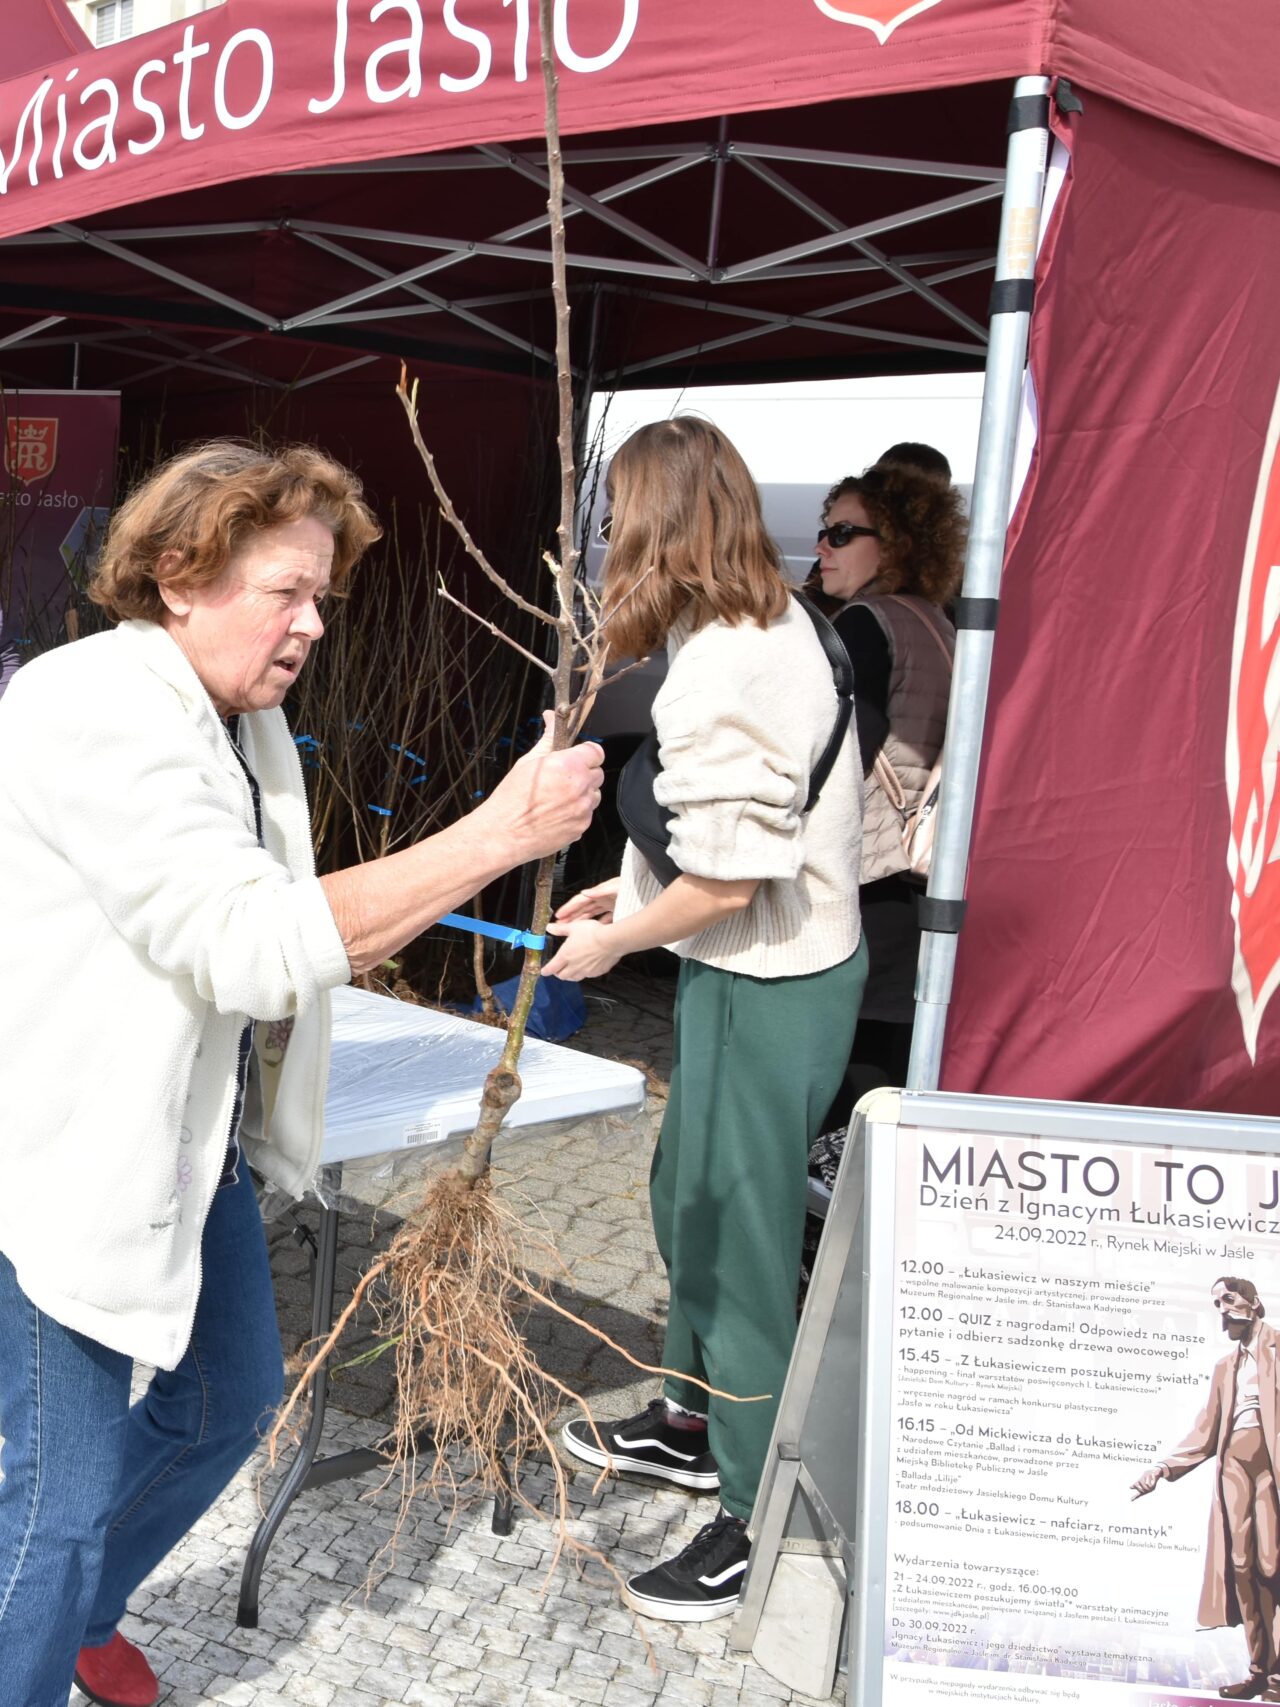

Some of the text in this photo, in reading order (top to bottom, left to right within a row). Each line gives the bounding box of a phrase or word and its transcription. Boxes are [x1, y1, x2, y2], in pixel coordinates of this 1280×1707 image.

[922, 1143, 1119, 1196] MIASTO
[1154, 1160, 1224, 1205] TO
[919, 1183, 988, 1211] Dzień
[998, 1199, 1009, 1213] z
[1019, 1192, 1120, 1223] Ignacym
[994, 1223, 1086, 1246] 24.09.2022
[1106, 1234, 1149, 1252] Rynek
[1153, 1239, 1201, 1257] Miejski
[1204, 1247, 1216, 1256] w
[1219, 1243, 1254, 1260] Jaśle
[900, 1259, 944, 1275] 12.00
[1054, 1277, 1100, 1290] naszym
[899, 1305, 943, 1322] 12.00
[958, 1312, 991, 1326] QUIZ
[1006, 1319, 1075, 1332] nagrodami!
[1078, 1322, 1148, 1339] Odpowiedz
[1170, 1333, 1205, 1344] nasze
[899, 1326, 944, 1338] pytanie
[956, 1329, 1003, 1344] odbierz
[1007, 1334, 1065, 1352] sadzonkę
[1068, 1338, 1113, 1353] drzewa
[1116, 1346, 1189, 1361] owocowego!
[898, 1347, 940, 1363] 15.45
[973, 1355, 1066, 1374] Łukasiewiczem
[1070, 1366, 1152, 1383] poszukujemy
[897, 1416, 935, 1432] 16.15
[978, 1425, 1052, 1443] Mickiewicza
[1055, 1432, 1072, 1444] do
[895, 1499, 939, 1516] 18.00
[1050, 1516, 1103, 1532] nafciarz,
[893, 1552, 1039, 1578] Wydarzenia towarzyszące:
[892, 1570, 904, 1581] 21
[915, 1572, 974, 1588] 24.09.2022
[988, 1582, 1015, 1592] godz.
[1018, 1583, 1078, 1598] 16.00-19.00
[891, 1616, 906, 1628] Do
[908, 1618, 967, 1634] 30.09.2022
